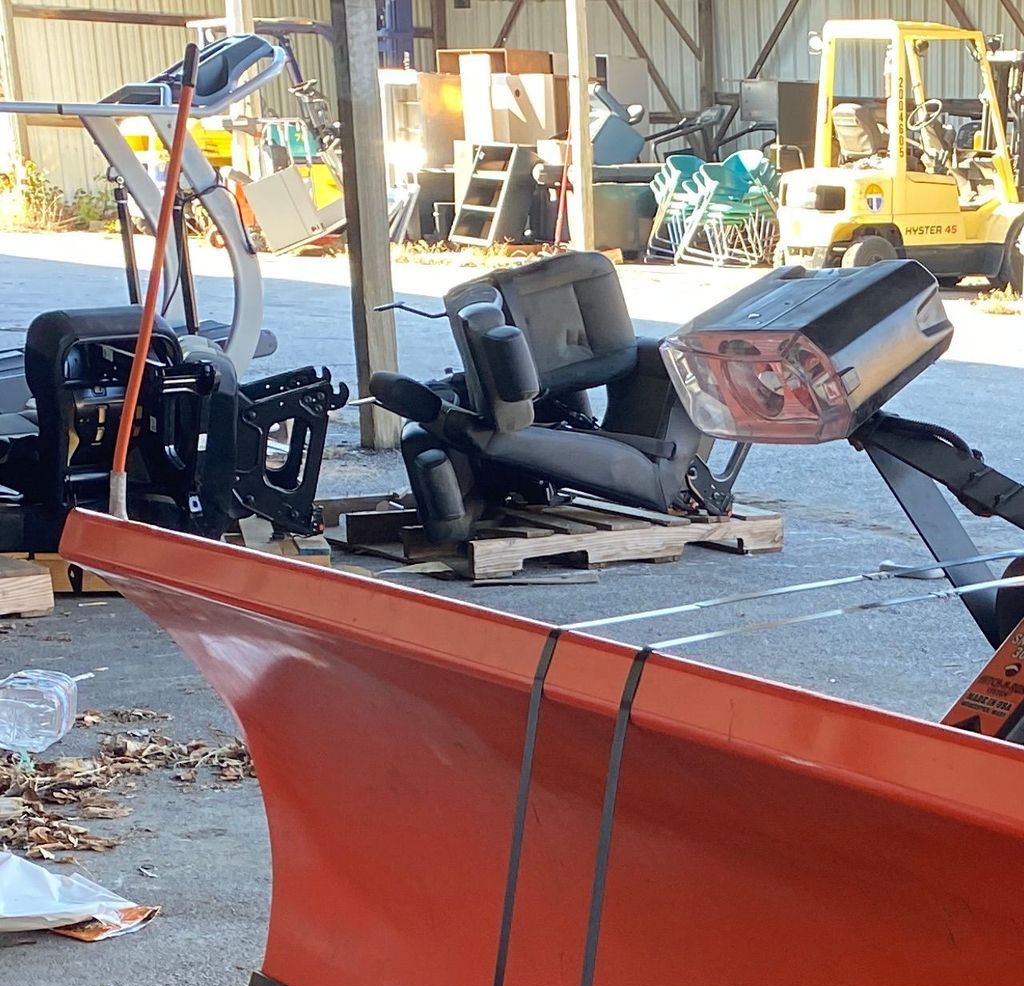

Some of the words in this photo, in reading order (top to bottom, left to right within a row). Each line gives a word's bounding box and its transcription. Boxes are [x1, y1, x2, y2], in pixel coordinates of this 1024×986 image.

[905, 225, 942, 235] HYSTER
[944, 224, 958, 234] 45
[966, 692, 989, 704] MADE
[996, 700, 1012, 711] USA
